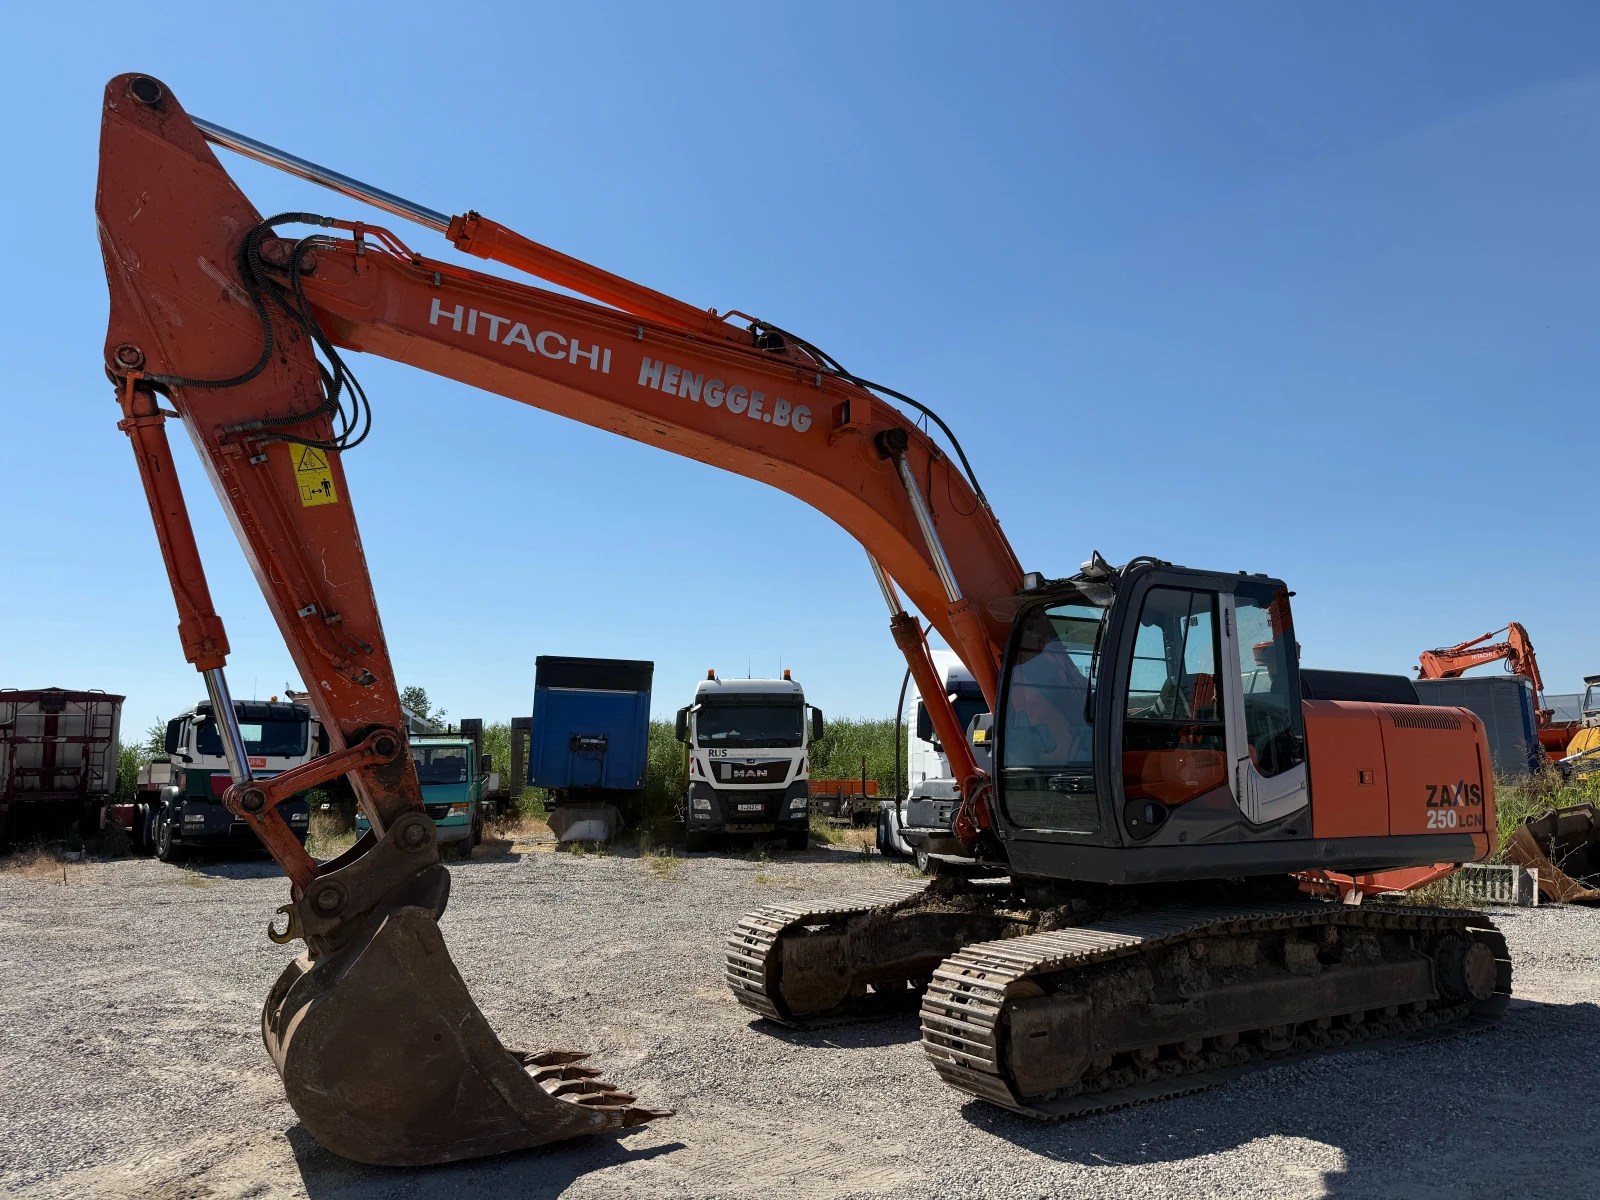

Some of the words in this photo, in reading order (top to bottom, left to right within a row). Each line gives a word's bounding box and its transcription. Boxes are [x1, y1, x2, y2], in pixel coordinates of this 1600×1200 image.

[429, 298, 611, 373] HITACHI
[638, 357, 812, 433] HENGGE.BG
[708, 749, 727, 757] RUS
[1426, 780, 1481, 807] ZAXIS
[1426, 809, 1457, 829] 250
[1459, 813, 1483, 828] LCN
